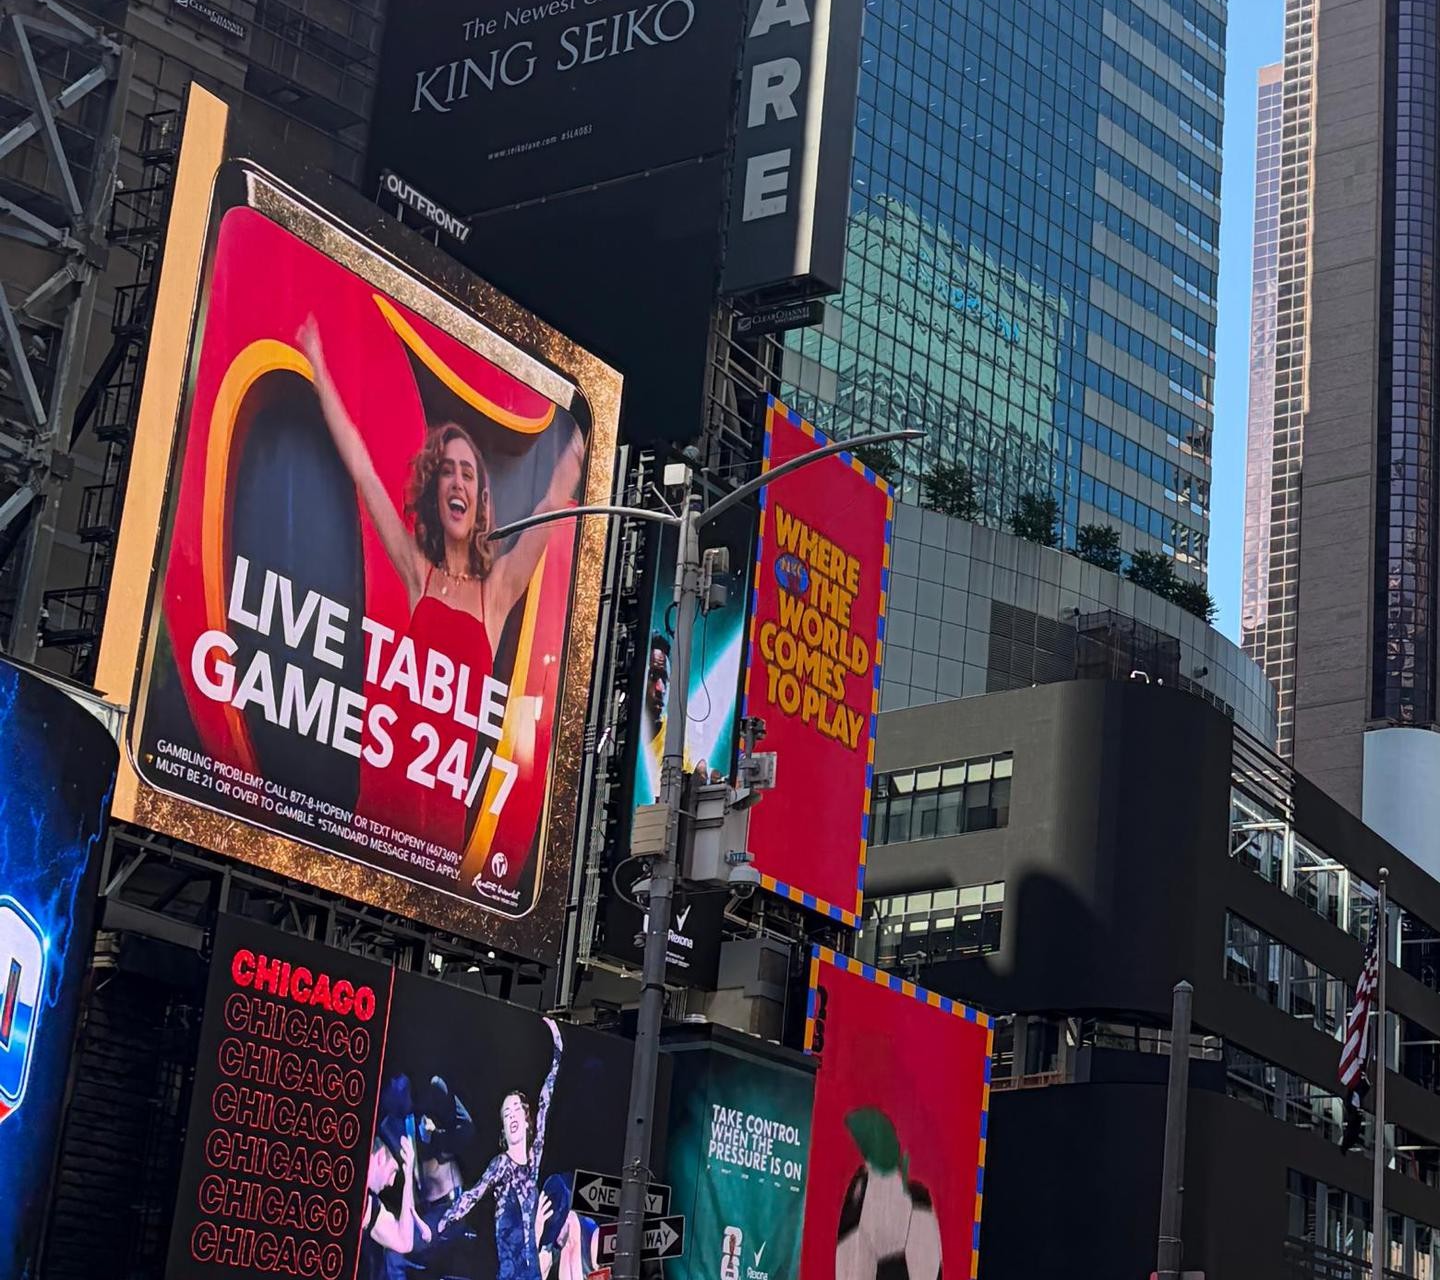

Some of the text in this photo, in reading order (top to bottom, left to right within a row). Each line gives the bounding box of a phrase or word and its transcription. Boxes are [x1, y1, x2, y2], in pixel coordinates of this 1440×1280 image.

[462, 17, 497, 41] The
[411, 41, 538, 113] KING
[774, 503, 859, 597] WHERE
[810, 575, 852, 628] THE
[227, 554, 509, 740] LIVE TABLE
[759, 622, 846, 701] COMES
[778, 600, 869, 679] WORLD
[192, 631, 519, 816] GAMES 24/7
[767, 665, 864, 750] TO PLAY
[155, 756, 185, 779] MUST
[186, 768, 200, 784] BE
[201, 775, 213, 789] 21
[215, 780, 230, 795] OR
[232, 786, 258, 806] OVER
[260, 795, 274, 810] TO
[275, 801, 315, 828] GAMBLE.
[370, 837, 408, 861] MESSAGE
[410, 852, 435, 871] RATES
[157, 739, 211, 770] GAMBLING
[213, 760, 264, 789] PROBLEM?
[265, 781, 288, 801] CALL
[290, 790, 353, 823] 877-8-HOPENY
[354, 815, 368, 829] OR
[369, 821, 390, 839] TEXT
[391, 828, 426, 849] HOPENY
[232, 949, 376, 1022] CHICAGO
[224, 992, 370, 1065] CHICAGO
[218, 1039, 366, 1106] CHICAGO
[212, 1083, 360, 1150] CHICAGO
[711, 1122, 774, 1156] WHEN THE
[713, 1104, 801, 1146] TAKE CONTROL
[205, 1128, 355, 1193] CHICAGO
[708, 1139, 767, 1172] PRESSURE
[770, 1155, 781, 1175] IS
[783, 1160, 802, 1181] ON
[199, 1174, 349, 1237] CHICAGO
[588, 1186, 616, 1205] ONE
[191, 1220, 343, 1280] CHICAGO
